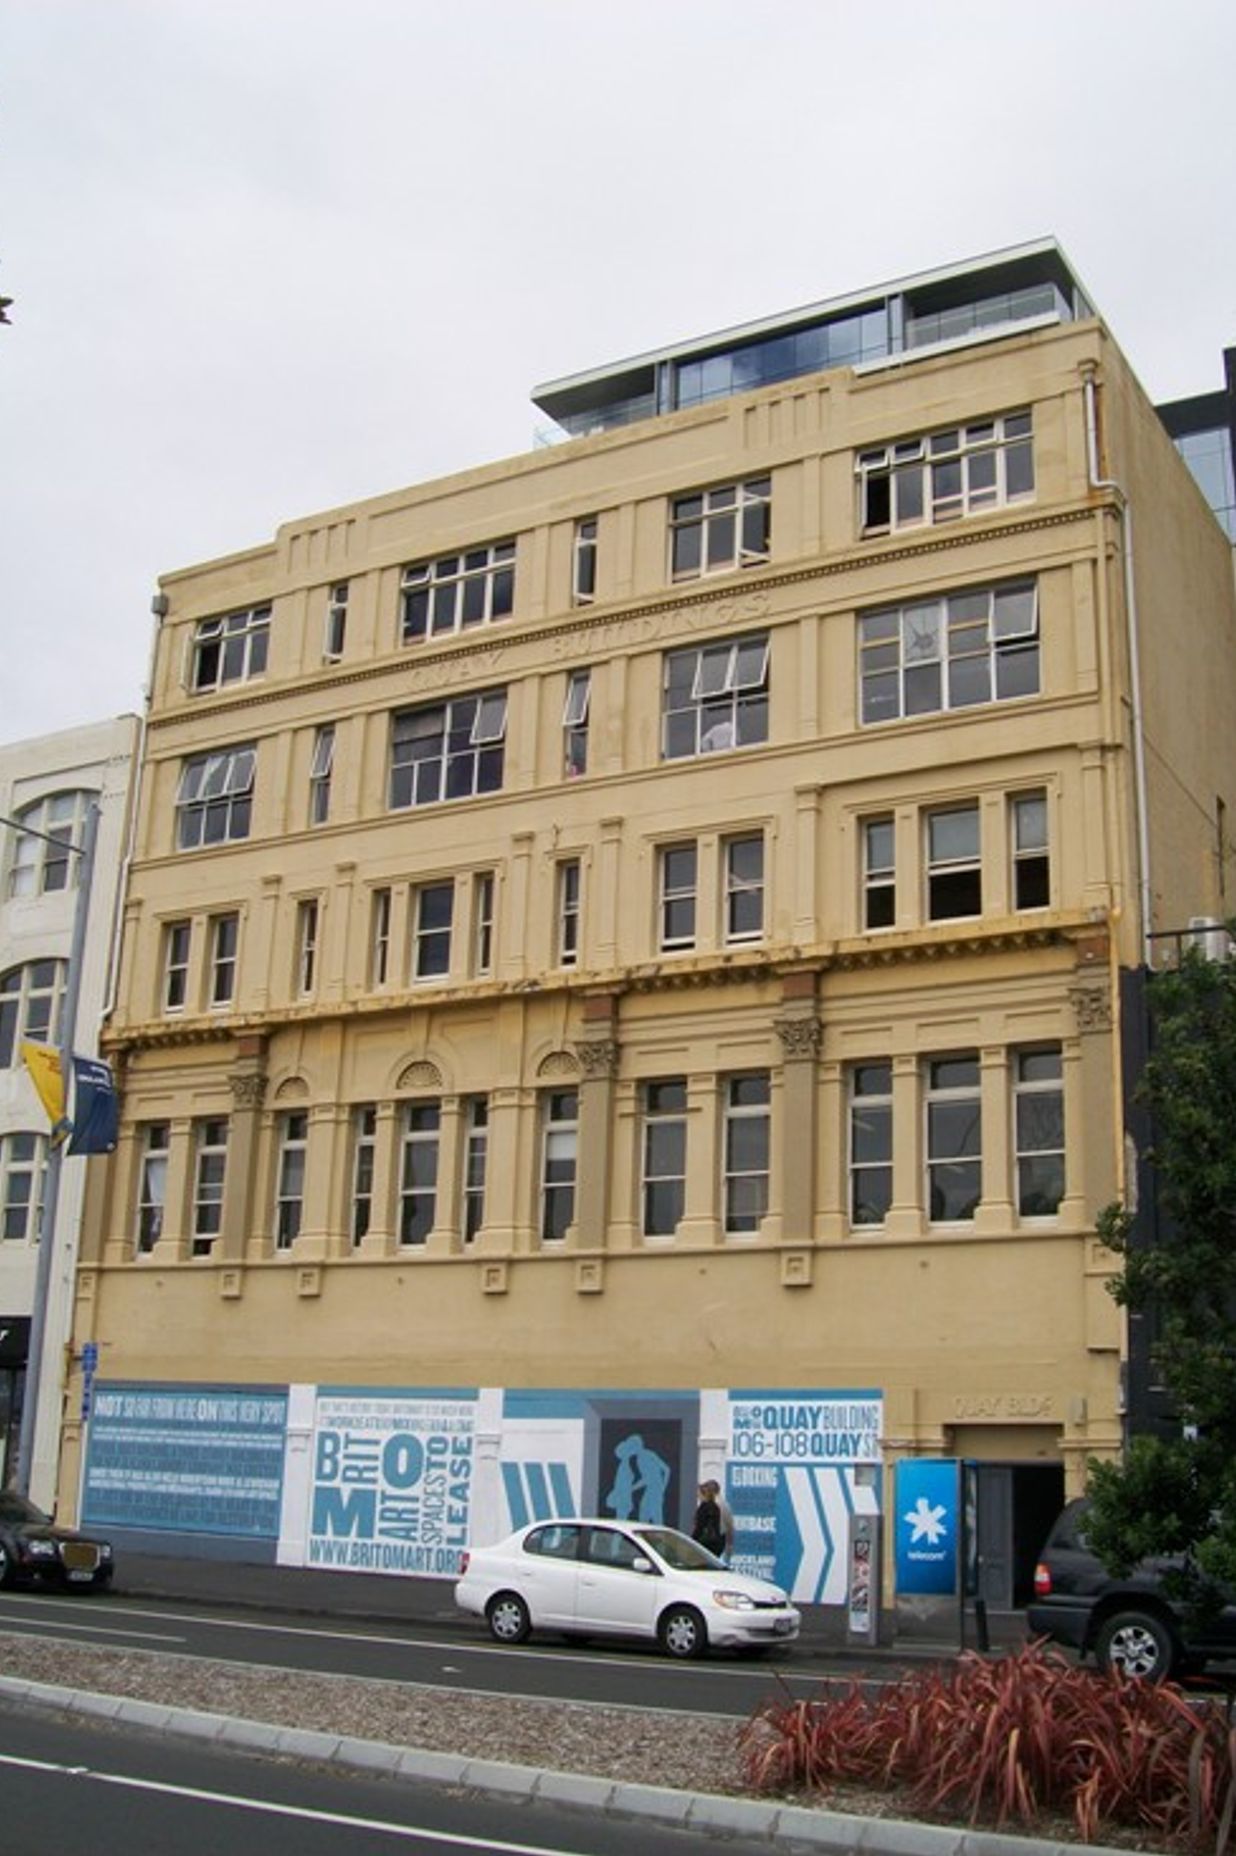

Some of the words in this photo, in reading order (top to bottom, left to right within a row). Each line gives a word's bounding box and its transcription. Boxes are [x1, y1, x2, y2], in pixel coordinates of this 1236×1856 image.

[552, 594, 772, 658] BUILDINGS
[763, 1406, 822, 1430] QUAY
[823, 1406, 879, 1430] BUILDING
[732, 1431, 808, 1457] 106-108
[811, 1432, 861, 1458] QUAY
[446, 1436, 473, 1546] LEASE
